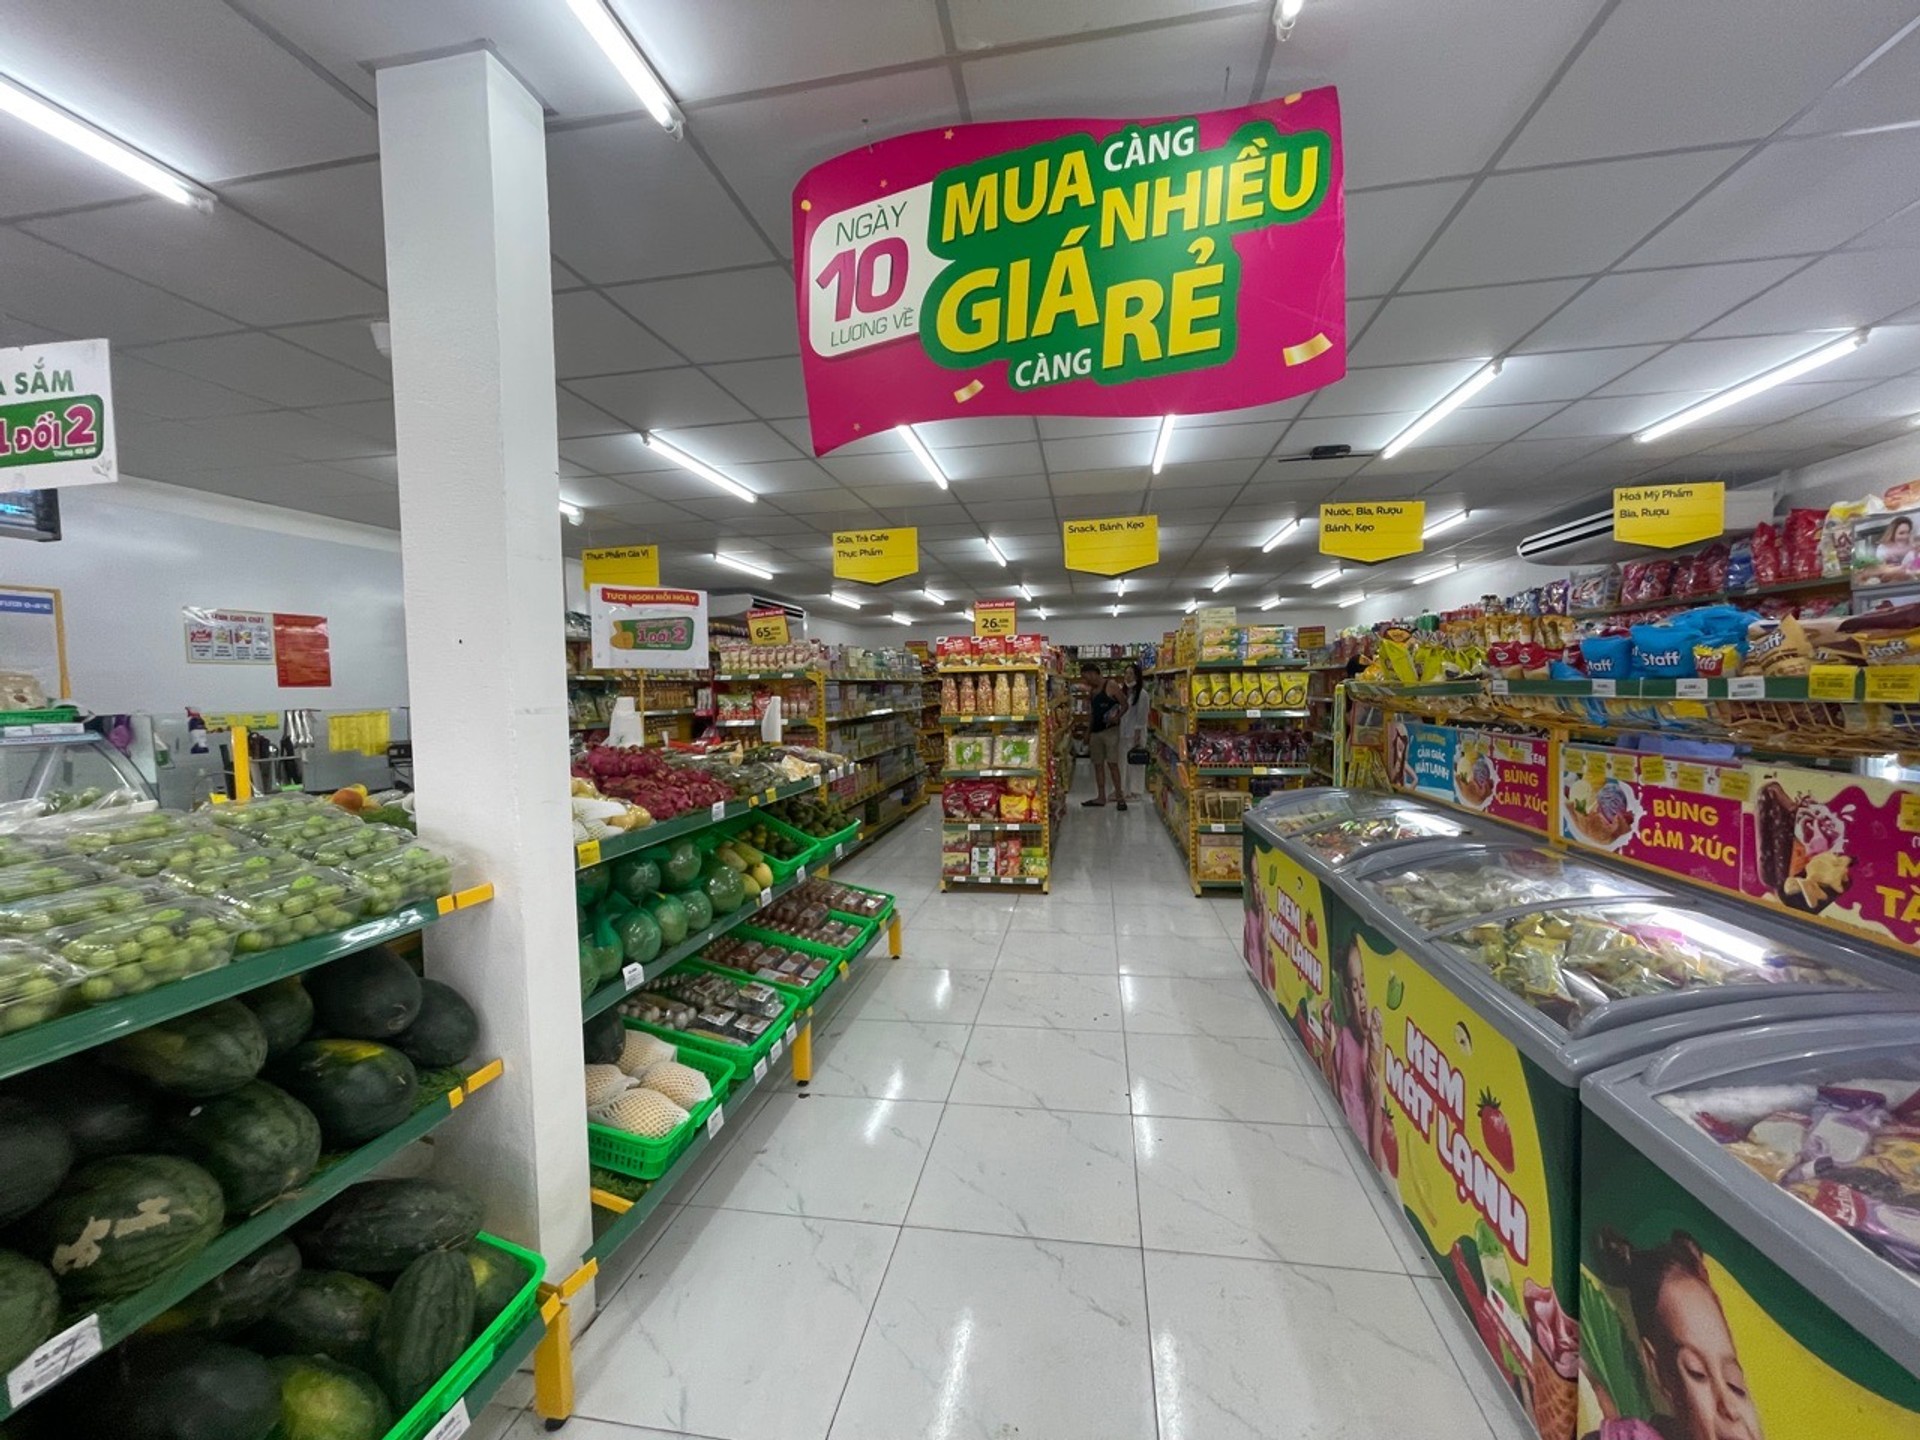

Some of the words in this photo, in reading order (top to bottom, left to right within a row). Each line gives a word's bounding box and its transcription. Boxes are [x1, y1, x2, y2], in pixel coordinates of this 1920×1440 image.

[1104, 124, 1195, 172] CÀNG
[942, 150, 1095, 243] MUA
[1101, 138, 1319, 249] NHIỀU
[836, 201, 908, 246] NGÀY
[815, 237, 909, 322] 10
[936, 226, 1100, 354] GIÁ
[1102, 236, 1224, 369] RẺ
[14, 357, 75, 395] SẮM
[1014, 347, 1092, 387] CÀNG
[14, 411, 62, 453] ĐỔI
[64, 403, 97, 447] 2
[1127, 521, 1145, 531] Kẹo
[1642, 650, 1680, 667] Staff
[1504, 765, 1540, 787] BÙNG
[1497, 786, 1522, 807] CẢM
[1524, 794, 1548, 816] XÚC
[1653, 794, 1719, 826] BÙNG
[1639, 822, 1684, 850] CẢM
[1690, 834, 1737, 867] XÚC
[1405, 1019, 1464, 1125] KEM
[1437, 1106, 1528, 1263] LẠNH
